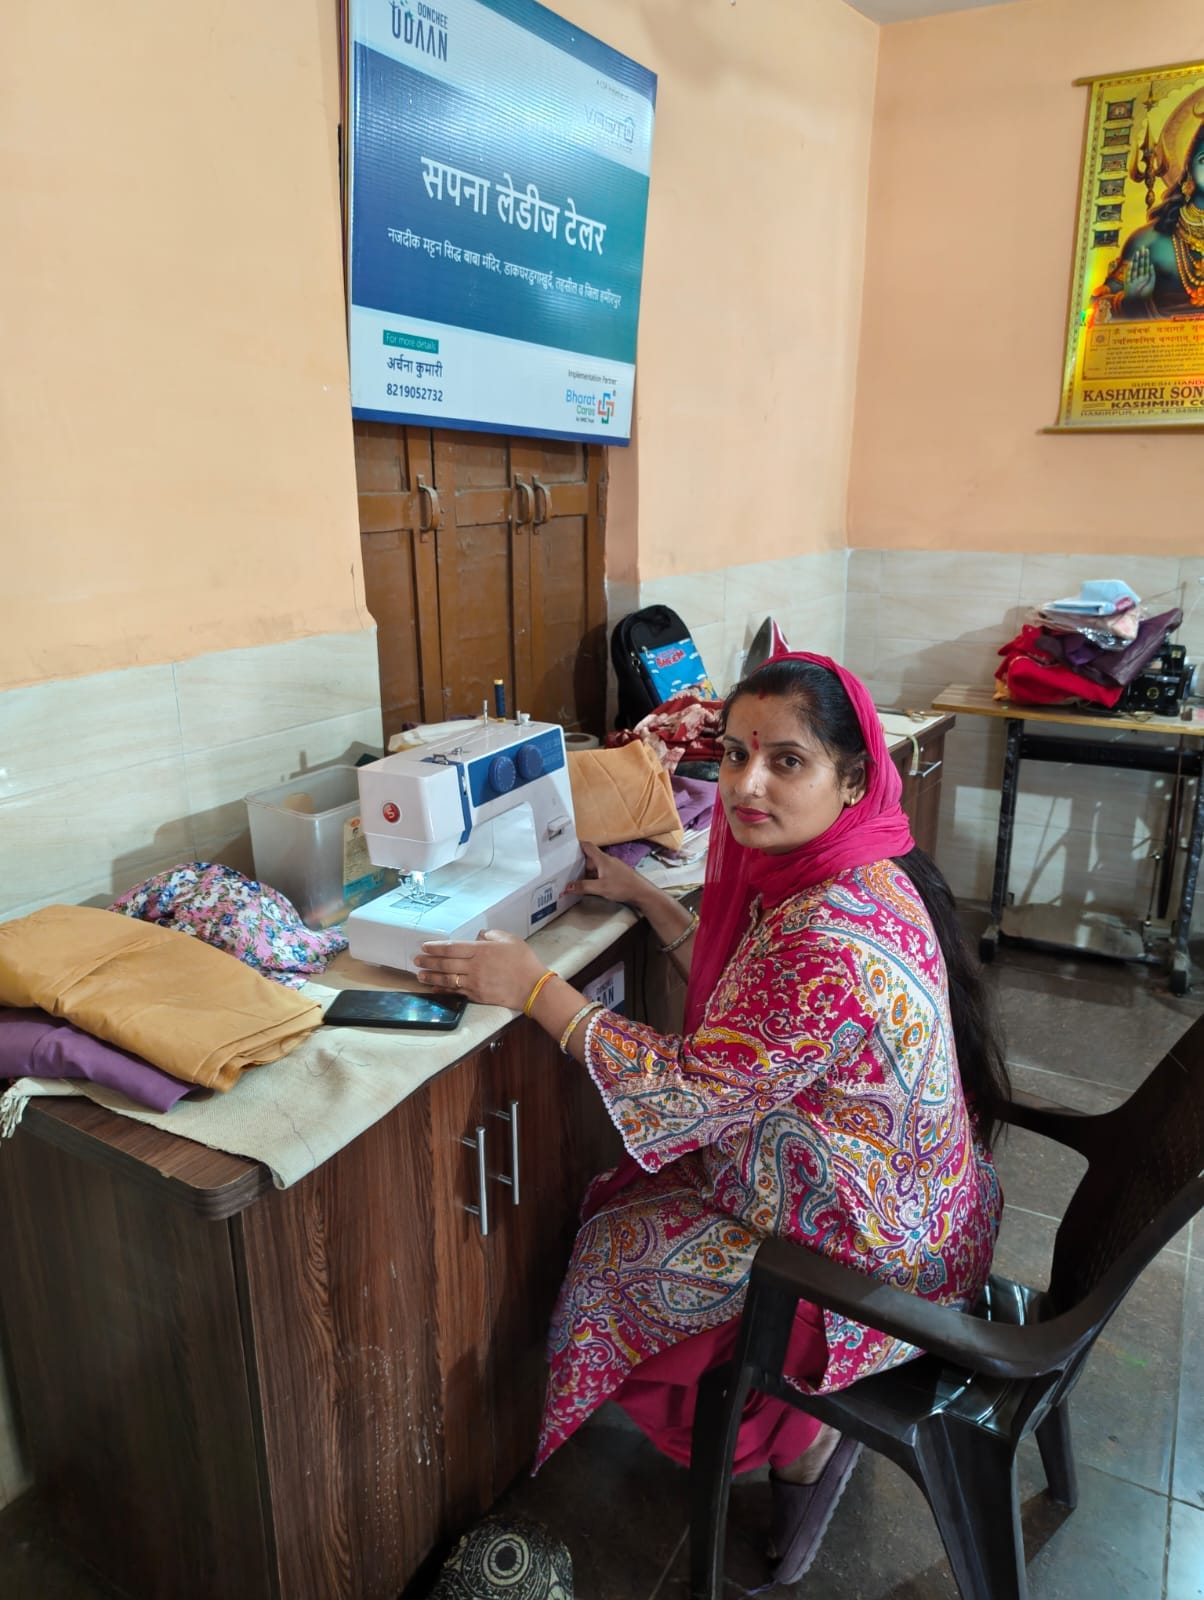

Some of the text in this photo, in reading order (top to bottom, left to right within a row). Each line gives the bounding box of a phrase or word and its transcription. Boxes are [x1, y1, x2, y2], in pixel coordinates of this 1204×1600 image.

[391, 4, 448, 63] UDAAN
[420, 156, 607, 256] सपना लेडीज टेलर
[387, 227, 421, 249] नजदीक
[463, 249, 481, 268] बाबा
[386, 332, 397, 342] For
[398, 337, 415, 347] more
[387, 353, 443, 379] अर्चना कुमारी
[386, 382, 443, 402] 8219052732
[1174, 378, 1204, 387] HAND
[566, 388, 596, 407] Bharat
[1082, 387, 1165, 402] KASHMIRI
[1110, 399, 1185, 409] KASHMIRI
